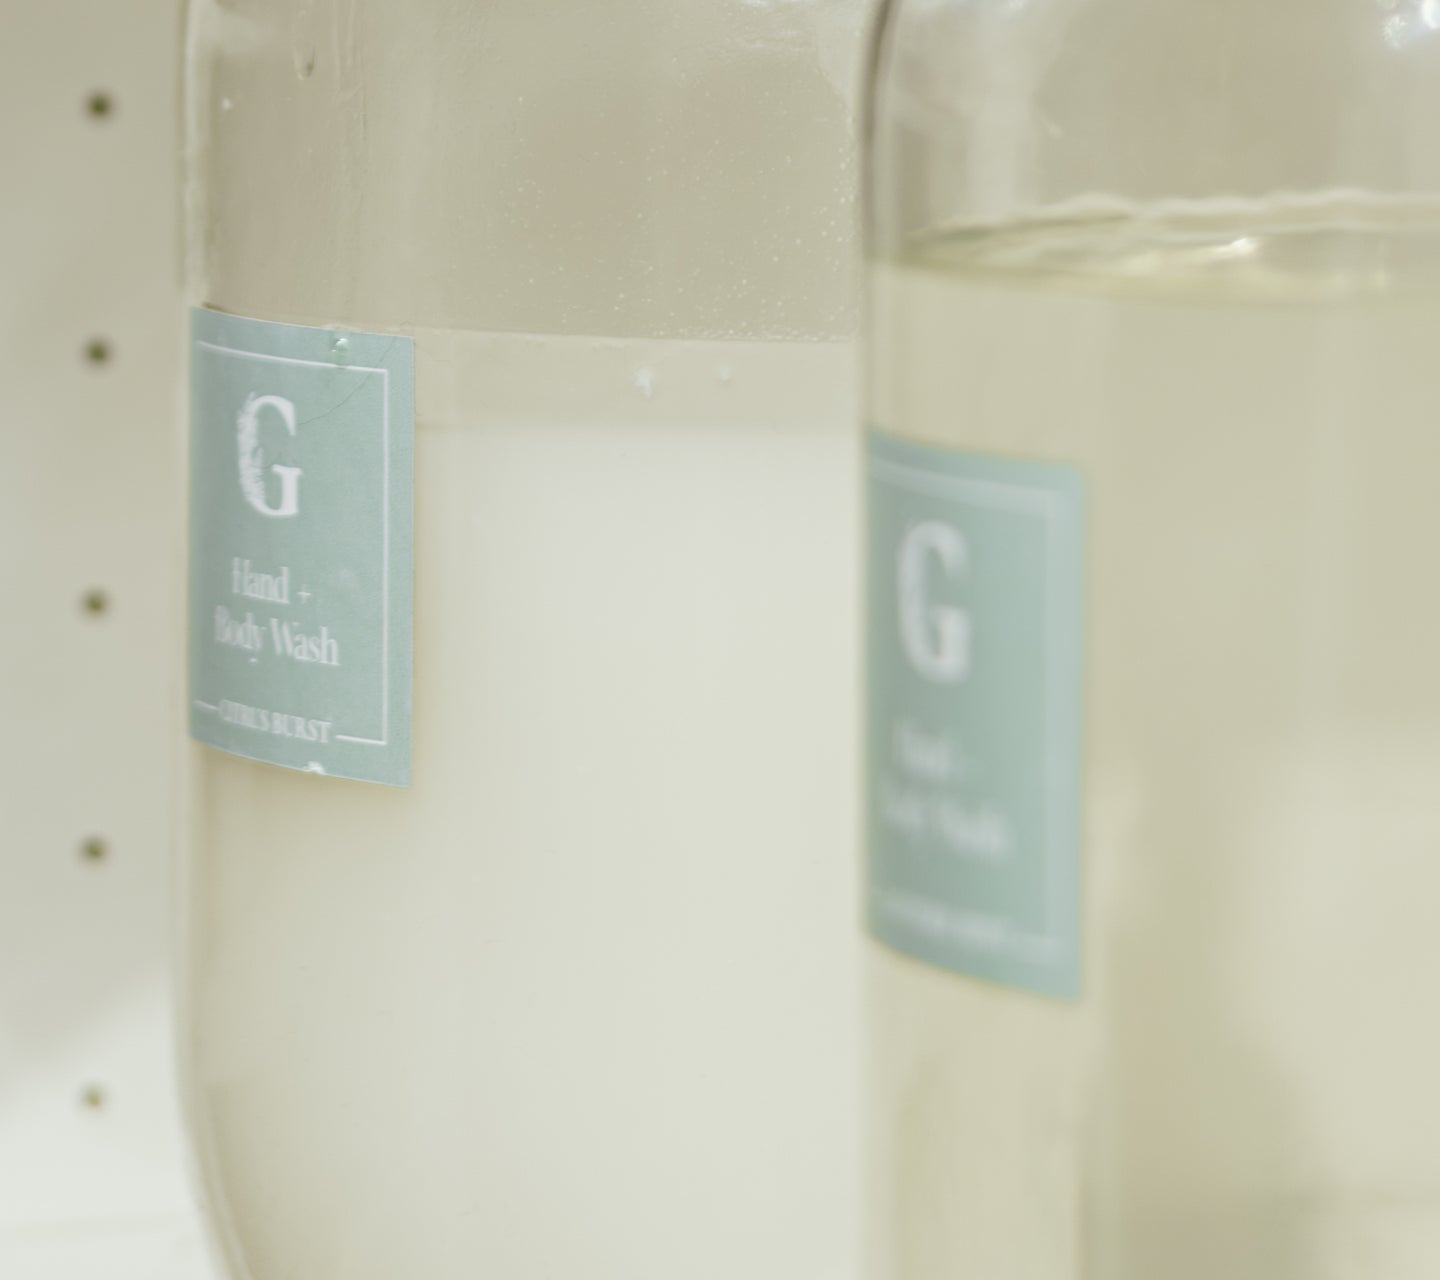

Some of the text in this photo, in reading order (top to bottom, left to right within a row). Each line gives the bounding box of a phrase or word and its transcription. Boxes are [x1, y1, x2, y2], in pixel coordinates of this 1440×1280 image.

[236, 391, 304, 518] G
[231, 557, 290, 604] Hand
[895, 520, 972, 686] G
[269, 618, 341, 666] Wash
